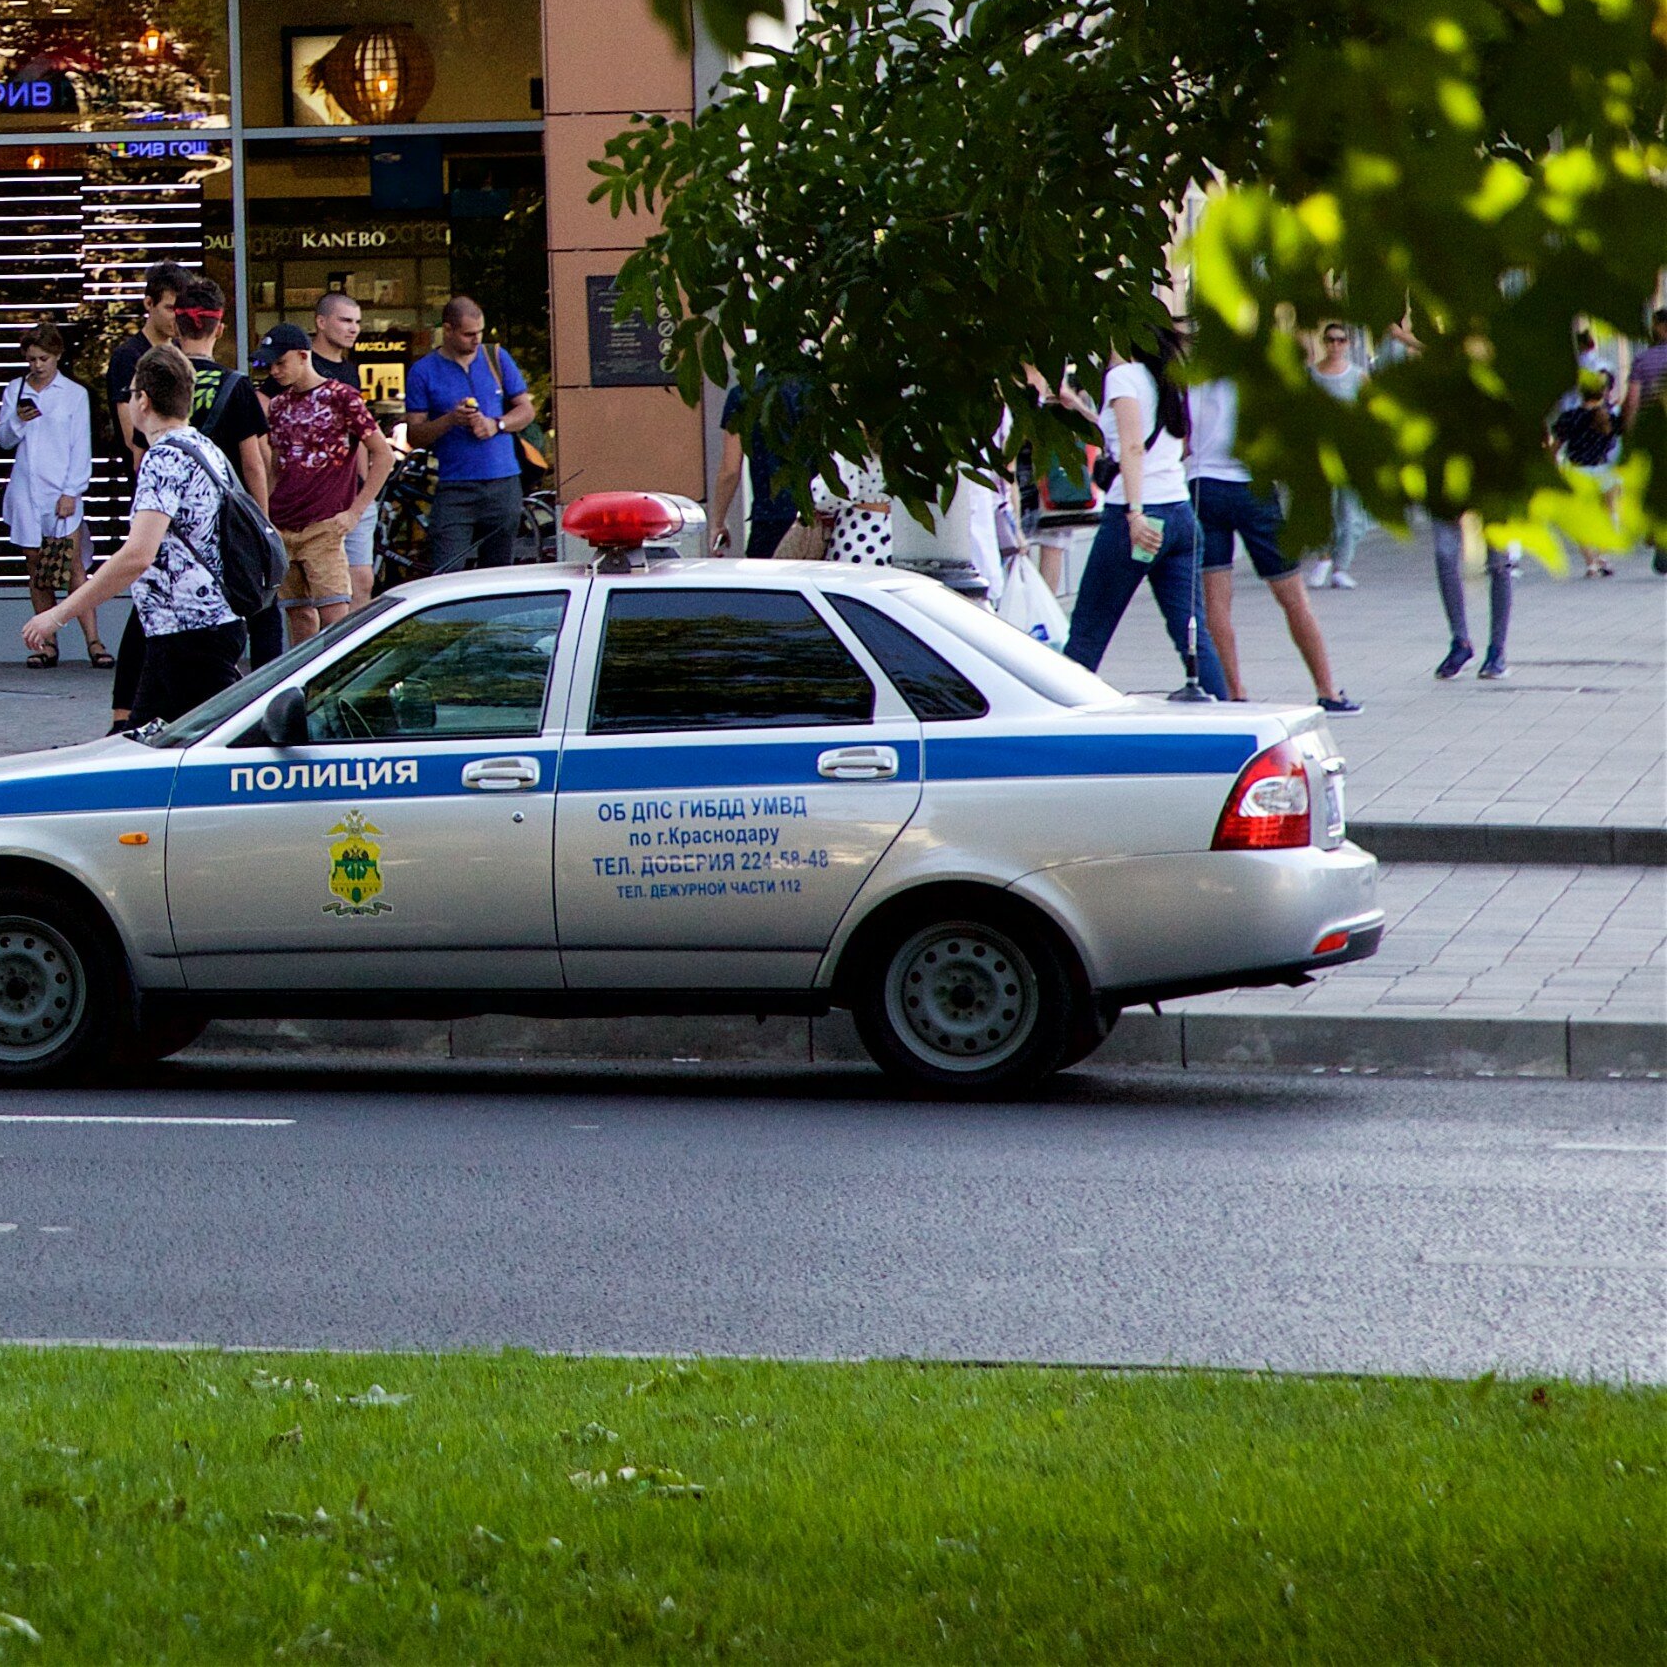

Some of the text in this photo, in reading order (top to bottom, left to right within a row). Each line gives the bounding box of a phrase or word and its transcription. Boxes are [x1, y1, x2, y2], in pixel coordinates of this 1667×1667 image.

[301, 230, 387, 249] KANEBO
[230, 759, 419, 792] ПОЛИЦИЯ
[597, 795, 808, 824] ОБ ДПС ГИБДД УМВД
[629, 826, 781, 848] по г.Краснодару
[592, 856, 636, 877] ТЕЛ.
[641, 854, 736, 878] ДОВЕРИЯ
[616, 878, 802, 901] ТЕЛ. ДЕЖУРНОЙ ЧАСТИ 112
